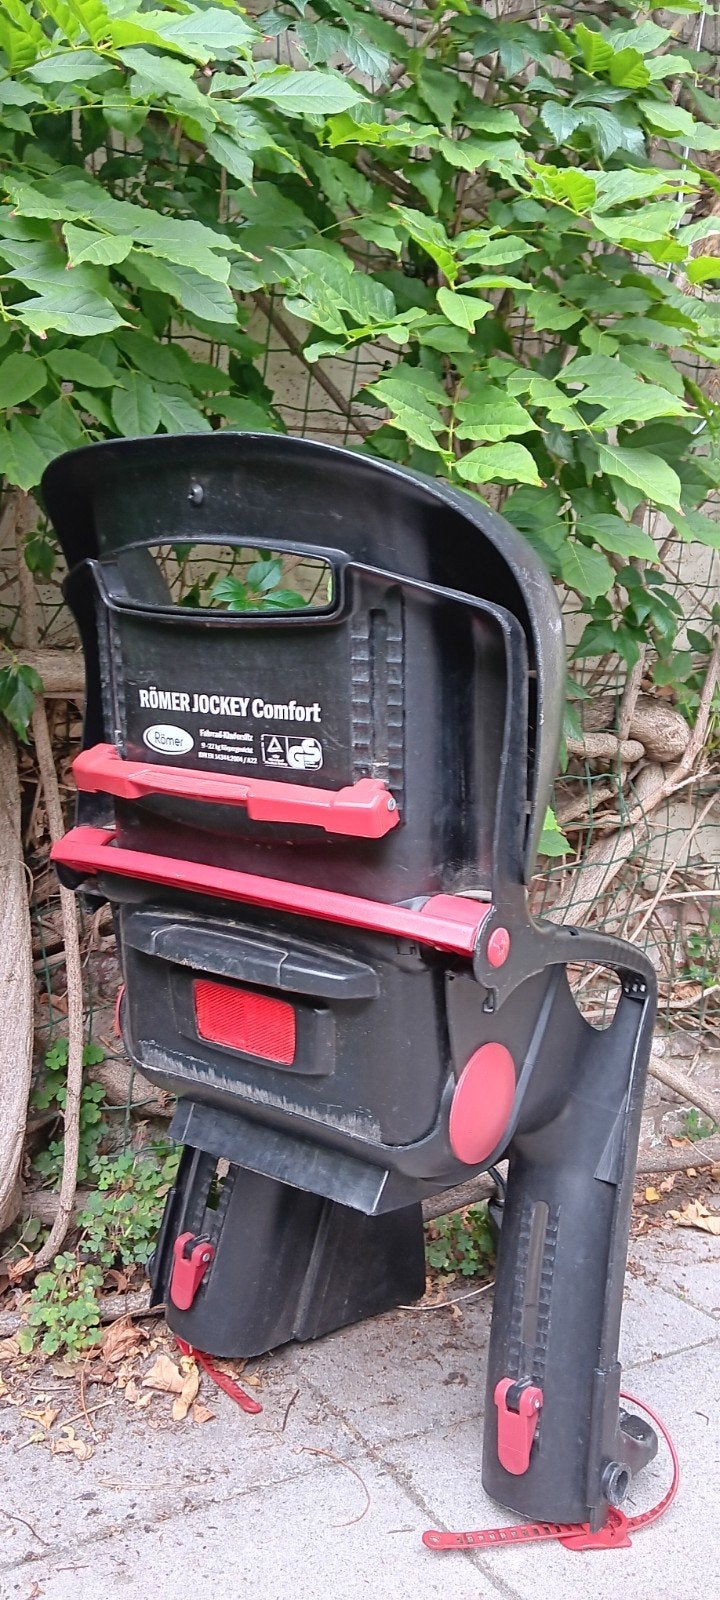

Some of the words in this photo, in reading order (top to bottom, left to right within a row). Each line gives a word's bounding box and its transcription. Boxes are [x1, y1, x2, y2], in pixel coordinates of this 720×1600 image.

[139, 686, 191, 712] RÖMER
[192, 693, 250, 717] JOCKEY
[251, 698, 321, 723] Comfort
[154, 731, 184, 747] Römer
